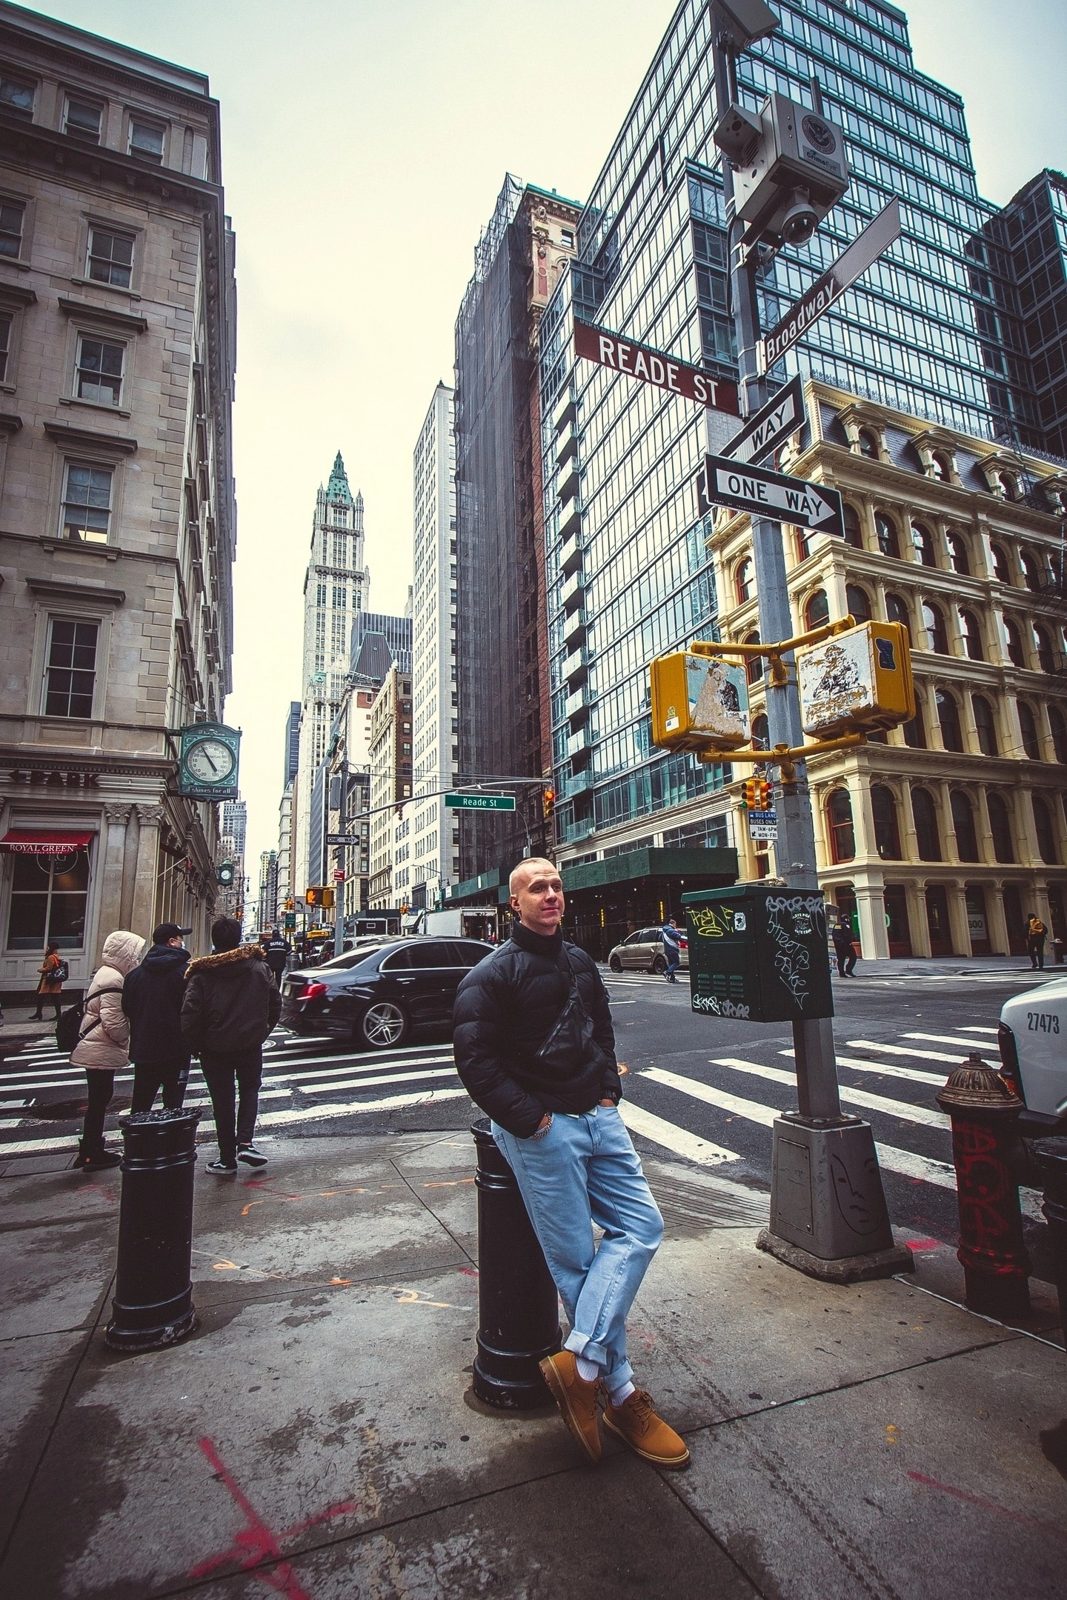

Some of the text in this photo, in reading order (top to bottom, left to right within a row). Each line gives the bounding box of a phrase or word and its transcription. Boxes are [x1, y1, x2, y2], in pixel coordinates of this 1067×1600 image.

[767, 279, 836, 362] Broadway
[599, 335, 682, 393] READE
[693, 374, 719, 406] ST
[751, 403, 788, 451] WAY
[728, 475, 823, 517] ONE WAY
[463, 798, 497, 807] Reade St
[9, 844, 41, 852] ROYAL
[1027, 1012, 1060, 1035] 27473
